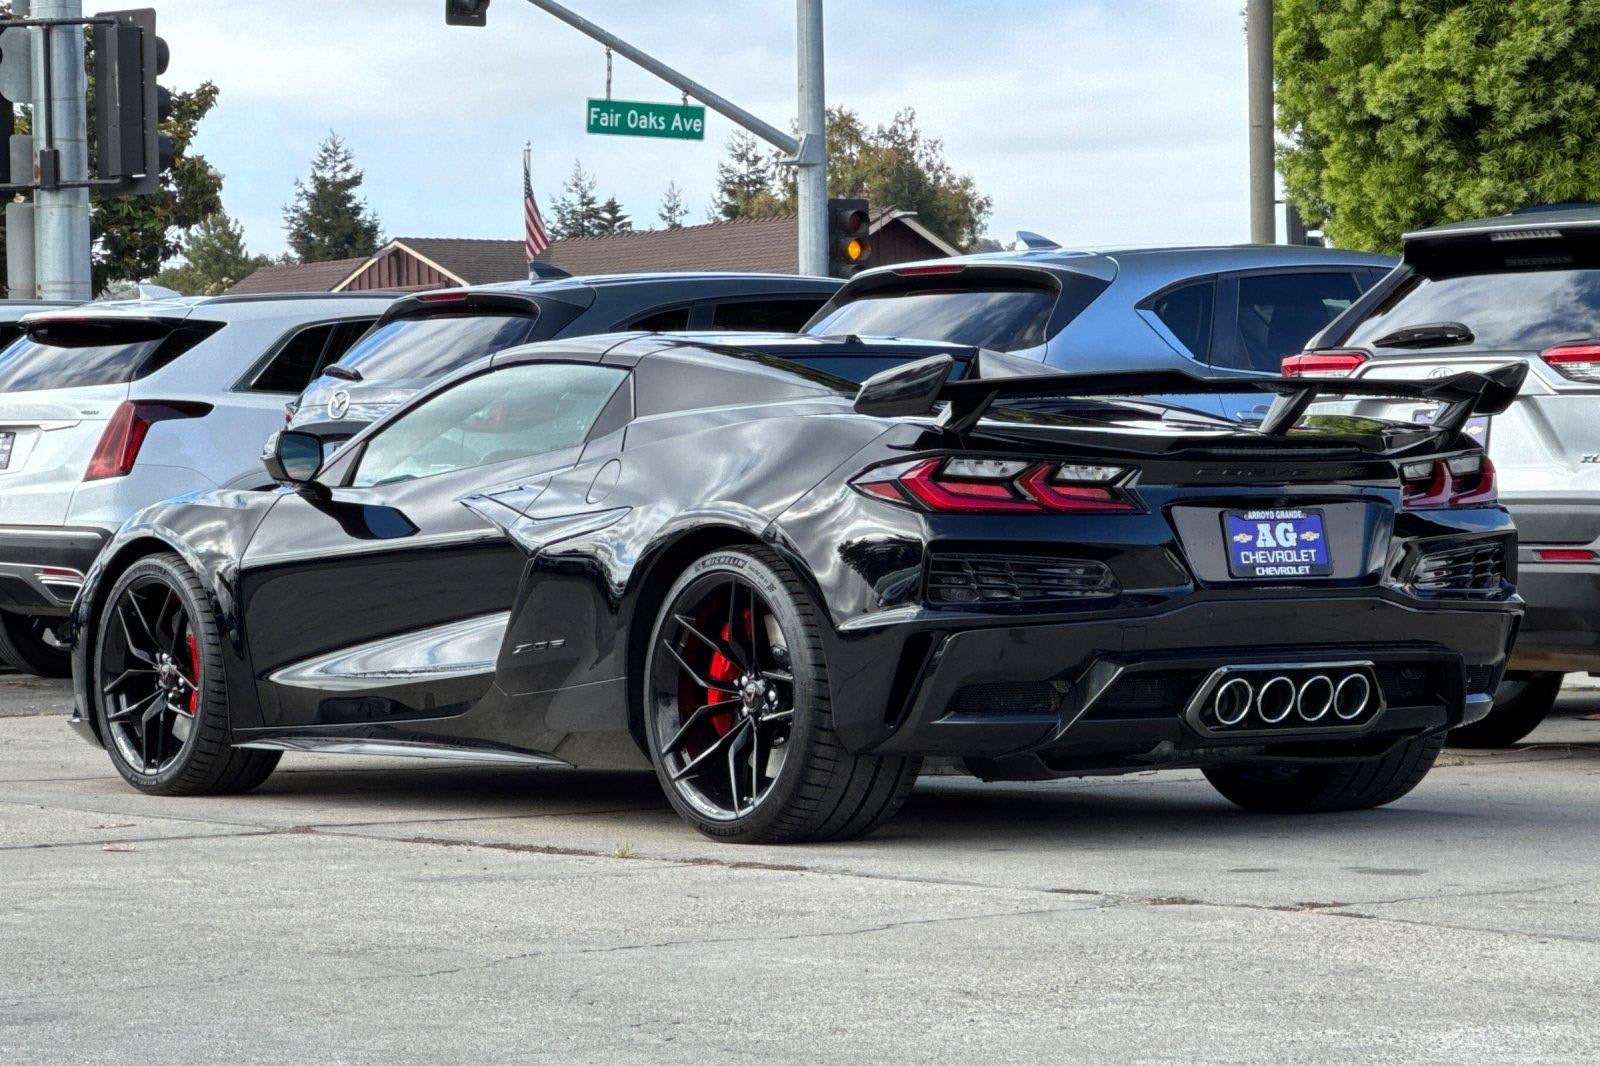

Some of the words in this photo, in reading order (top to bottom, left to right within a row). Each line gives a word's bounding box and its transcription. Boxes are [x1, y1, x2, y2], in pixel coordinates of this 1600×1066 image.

[590, 107, 621, 127] Fair
[627, 109, 666, 130] Oaks
[670, 112, 703, 132] Ave
[1247, 510, 1275, 520] ARROYO
[1275, 510, 1303, 519] GRANDE
[1256, 522, 1298, 547] AG
[1240, 549, 1317, 564] CHEVROLET
[1255, 565, 1311, 576] CHEVROLET
